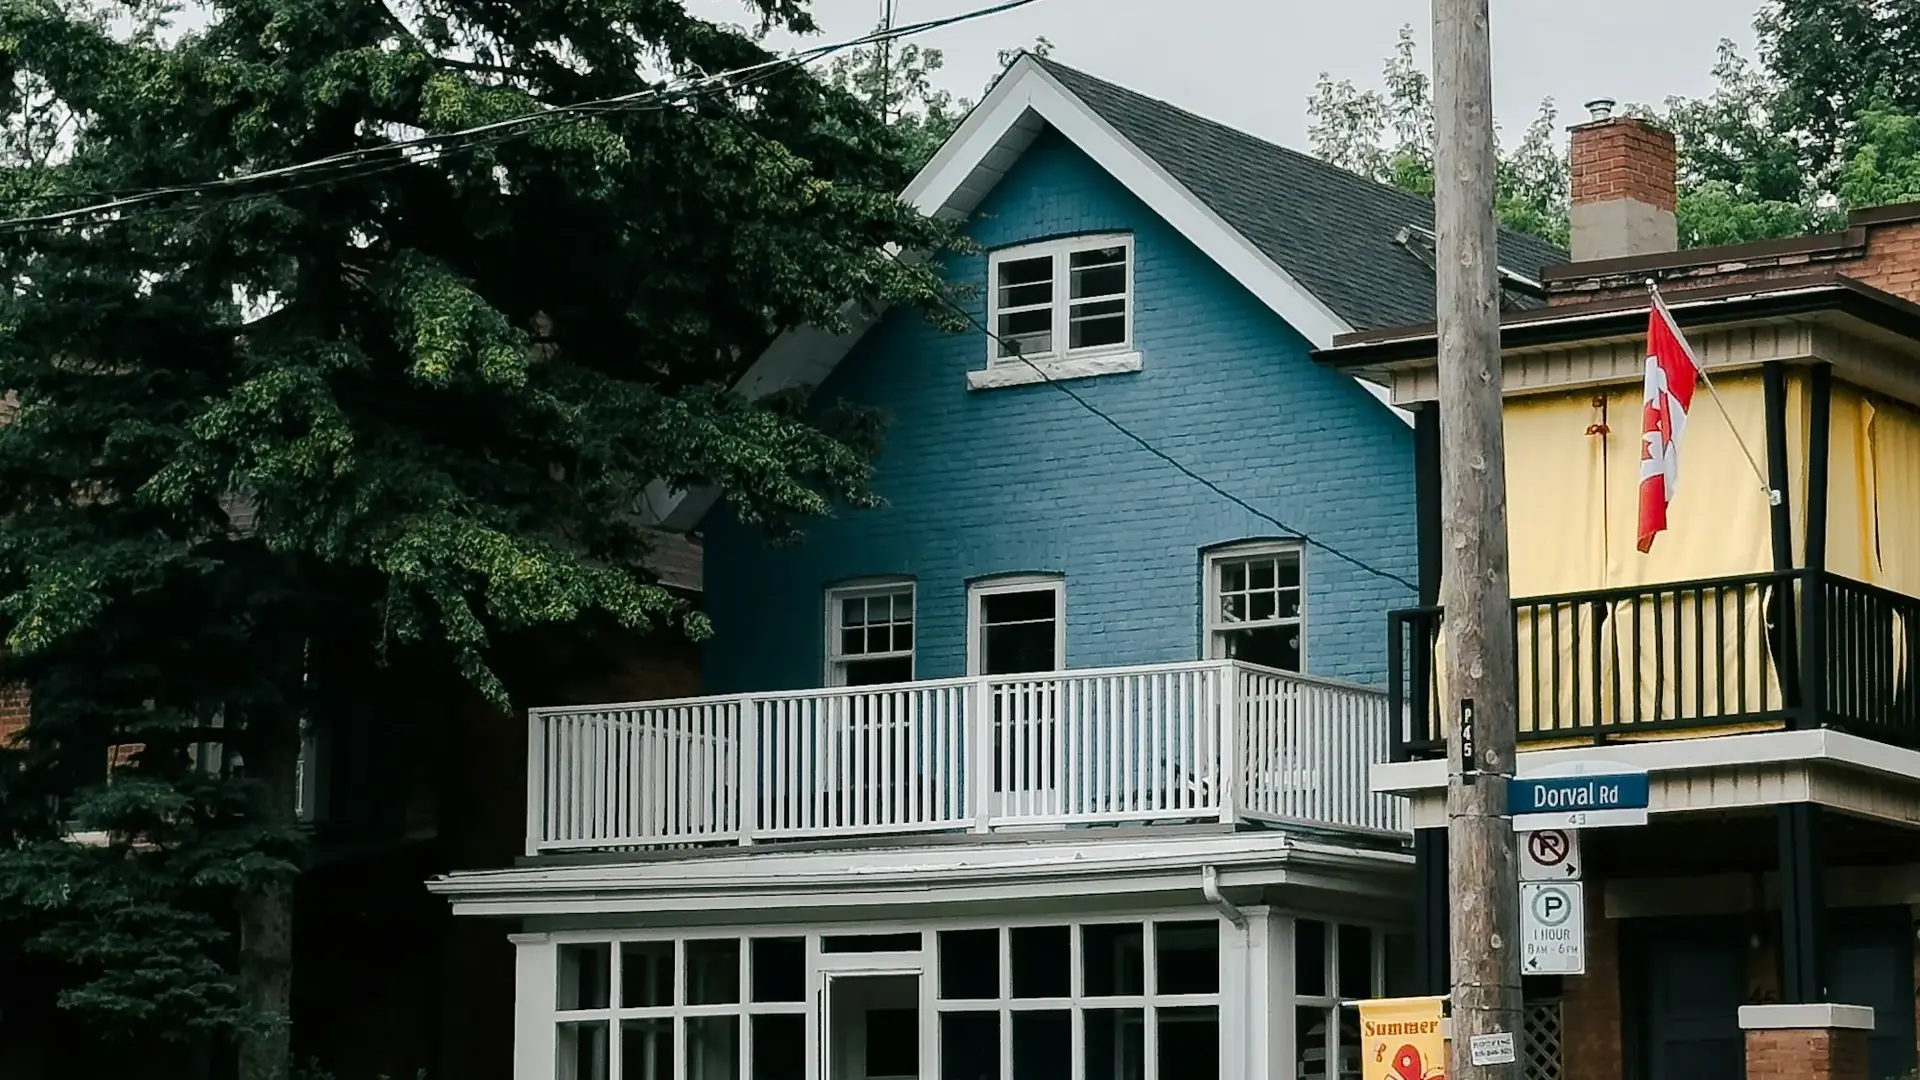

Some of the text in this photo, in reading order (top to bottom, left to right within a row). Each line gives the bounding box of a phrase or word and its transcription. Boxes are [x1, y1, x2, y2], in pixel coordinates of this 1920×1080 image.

[1463, 708, 1472, 757] P45
[1534, 782, 1619, 808] Dorval Rd
[1568, 814, 1586, 825] 43
[1545, 896, 1563, 918] P
[1541, 928, 1571, 941] HOUR
[1365, 1020, 1438, 1036] Summer
